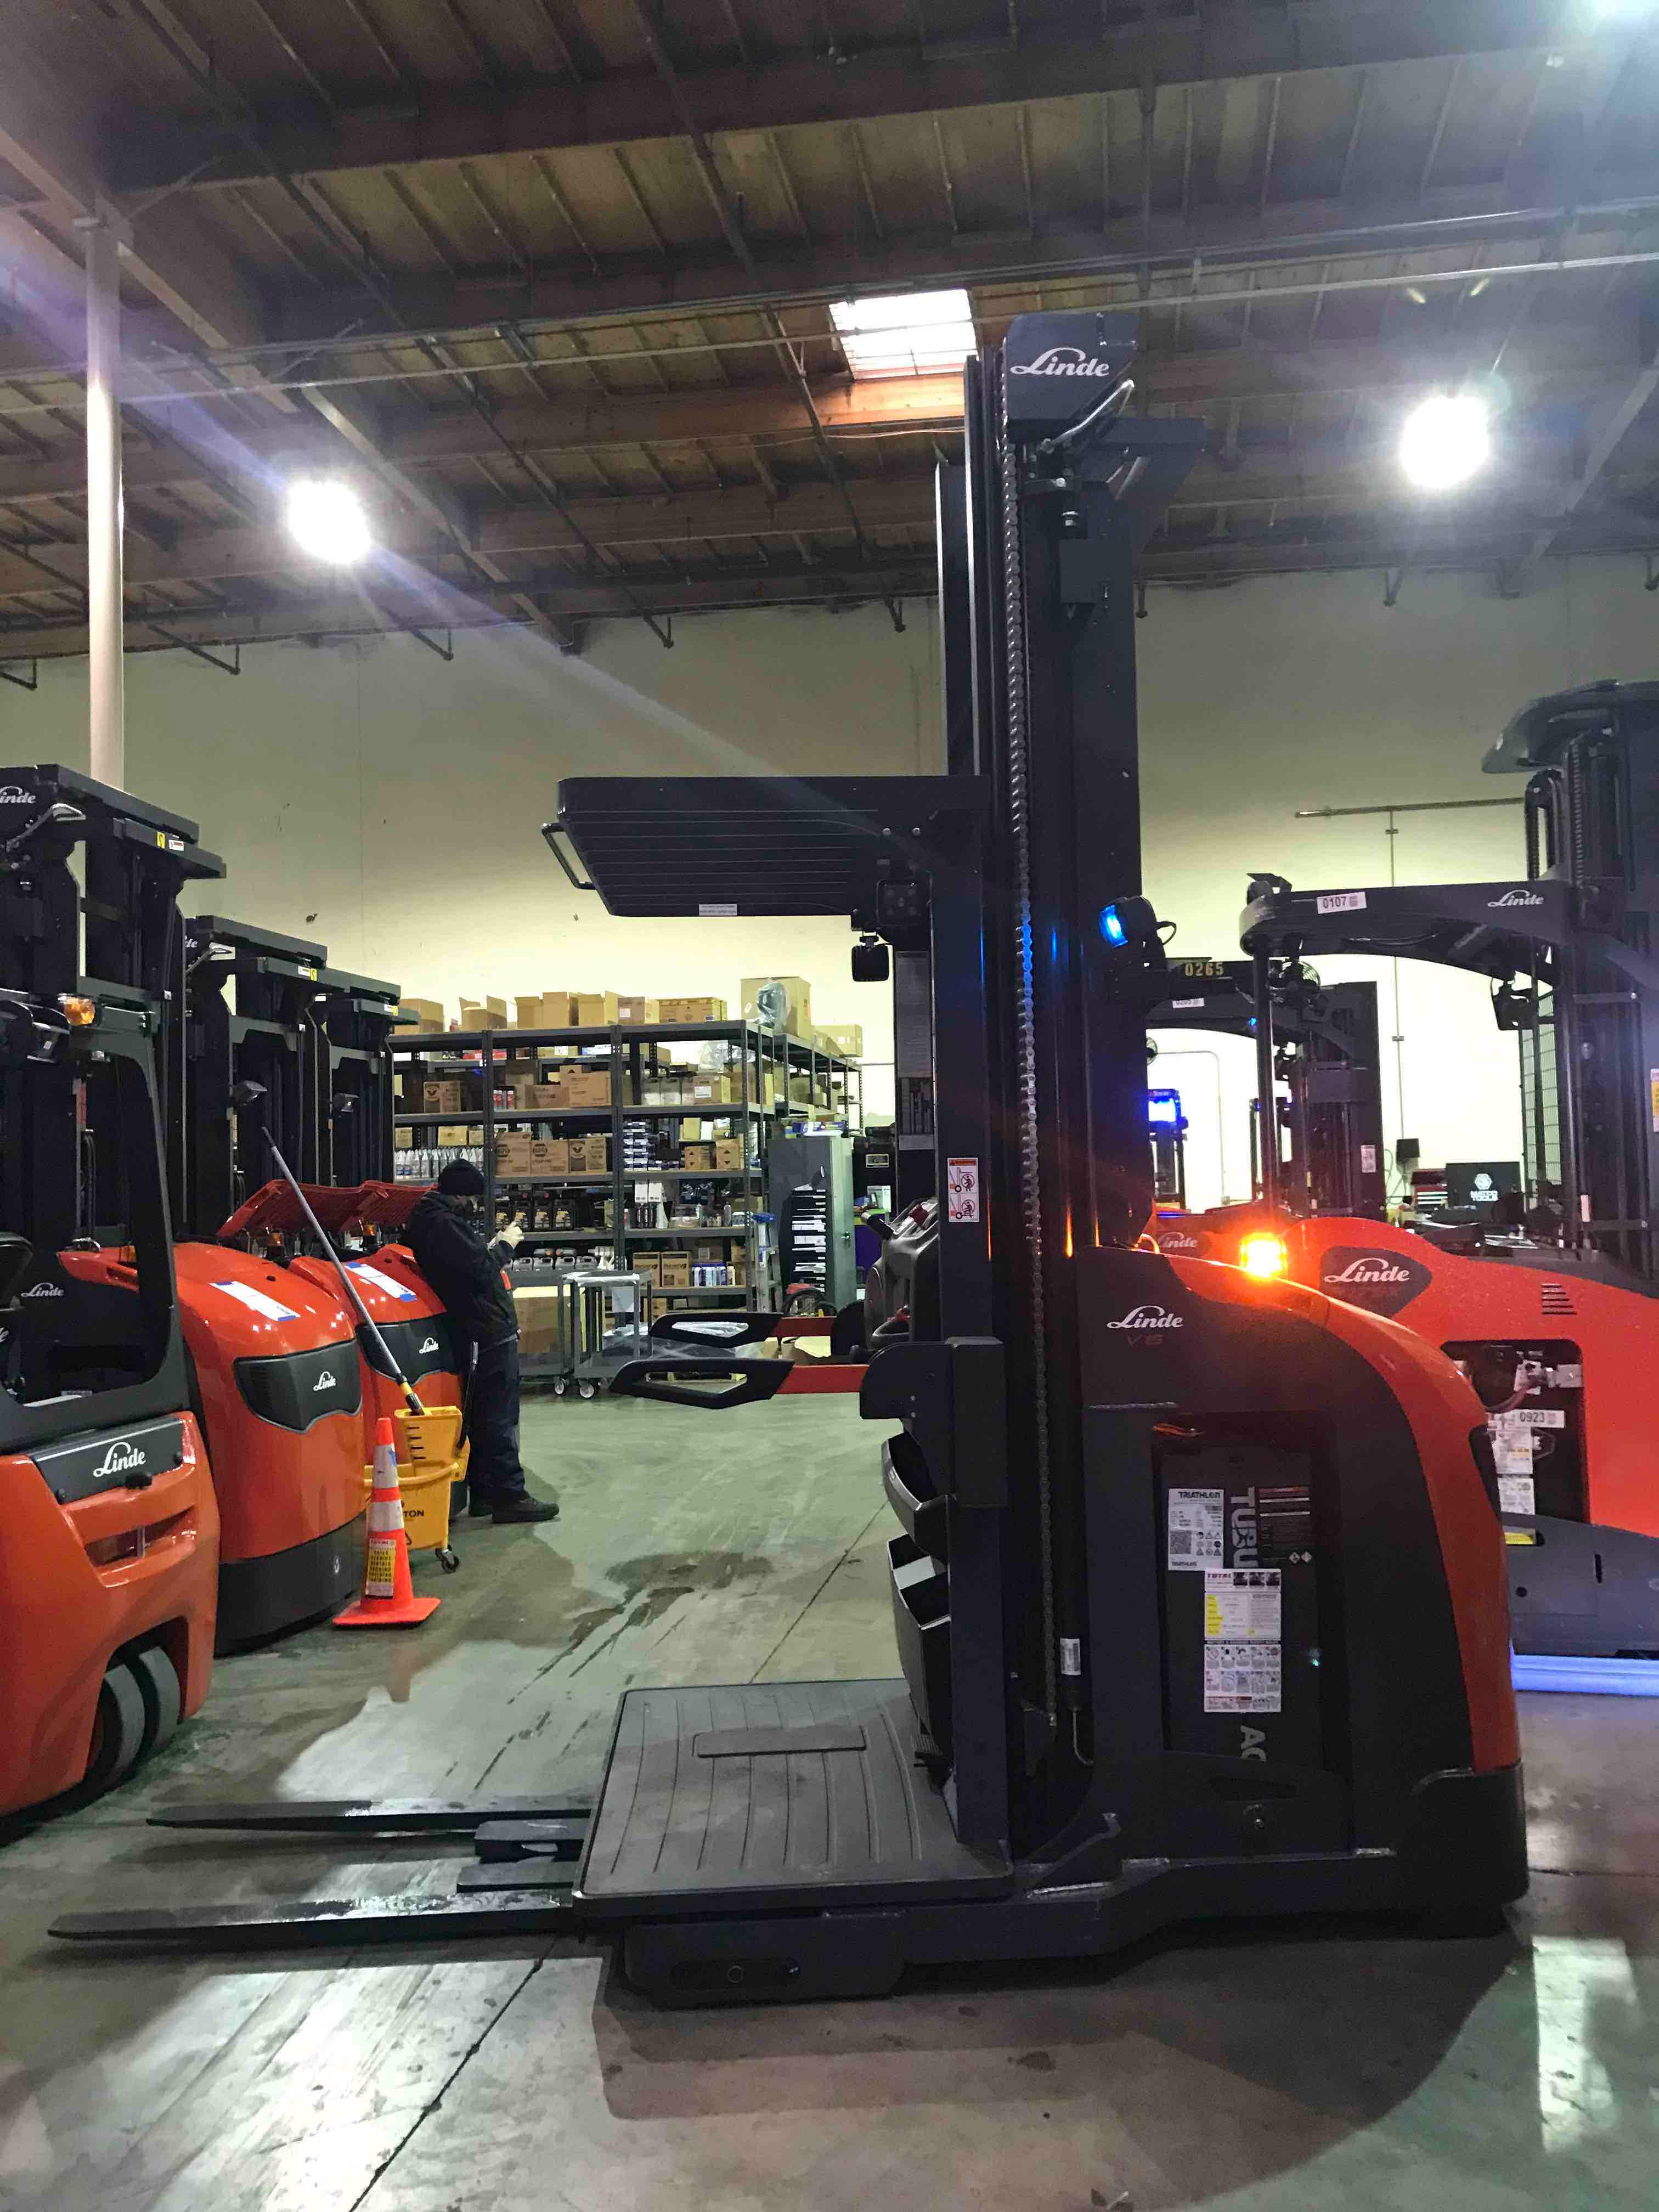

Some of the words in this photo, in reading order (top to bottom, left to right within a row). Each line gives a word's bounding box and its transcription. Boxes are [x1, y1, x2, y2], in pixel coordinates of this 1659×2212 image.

[1010, 347, 1109, 376] Linde
[1323, 896, 1346, 909] 0107
[1487, 889, 1544, 907] Linde
[1185, 962, 1224, 976] 0265
[1324, 1257, 1409, 1283] Linde
[20, 1283, 64, 1297] Linde
[1107, 1305, 1184, 1328] Linde
[313, 1372, 336, 1391] Linde
[1519, 1412, 1545, 1423] 0923
[93, 1442, 146, 1477] Linde
